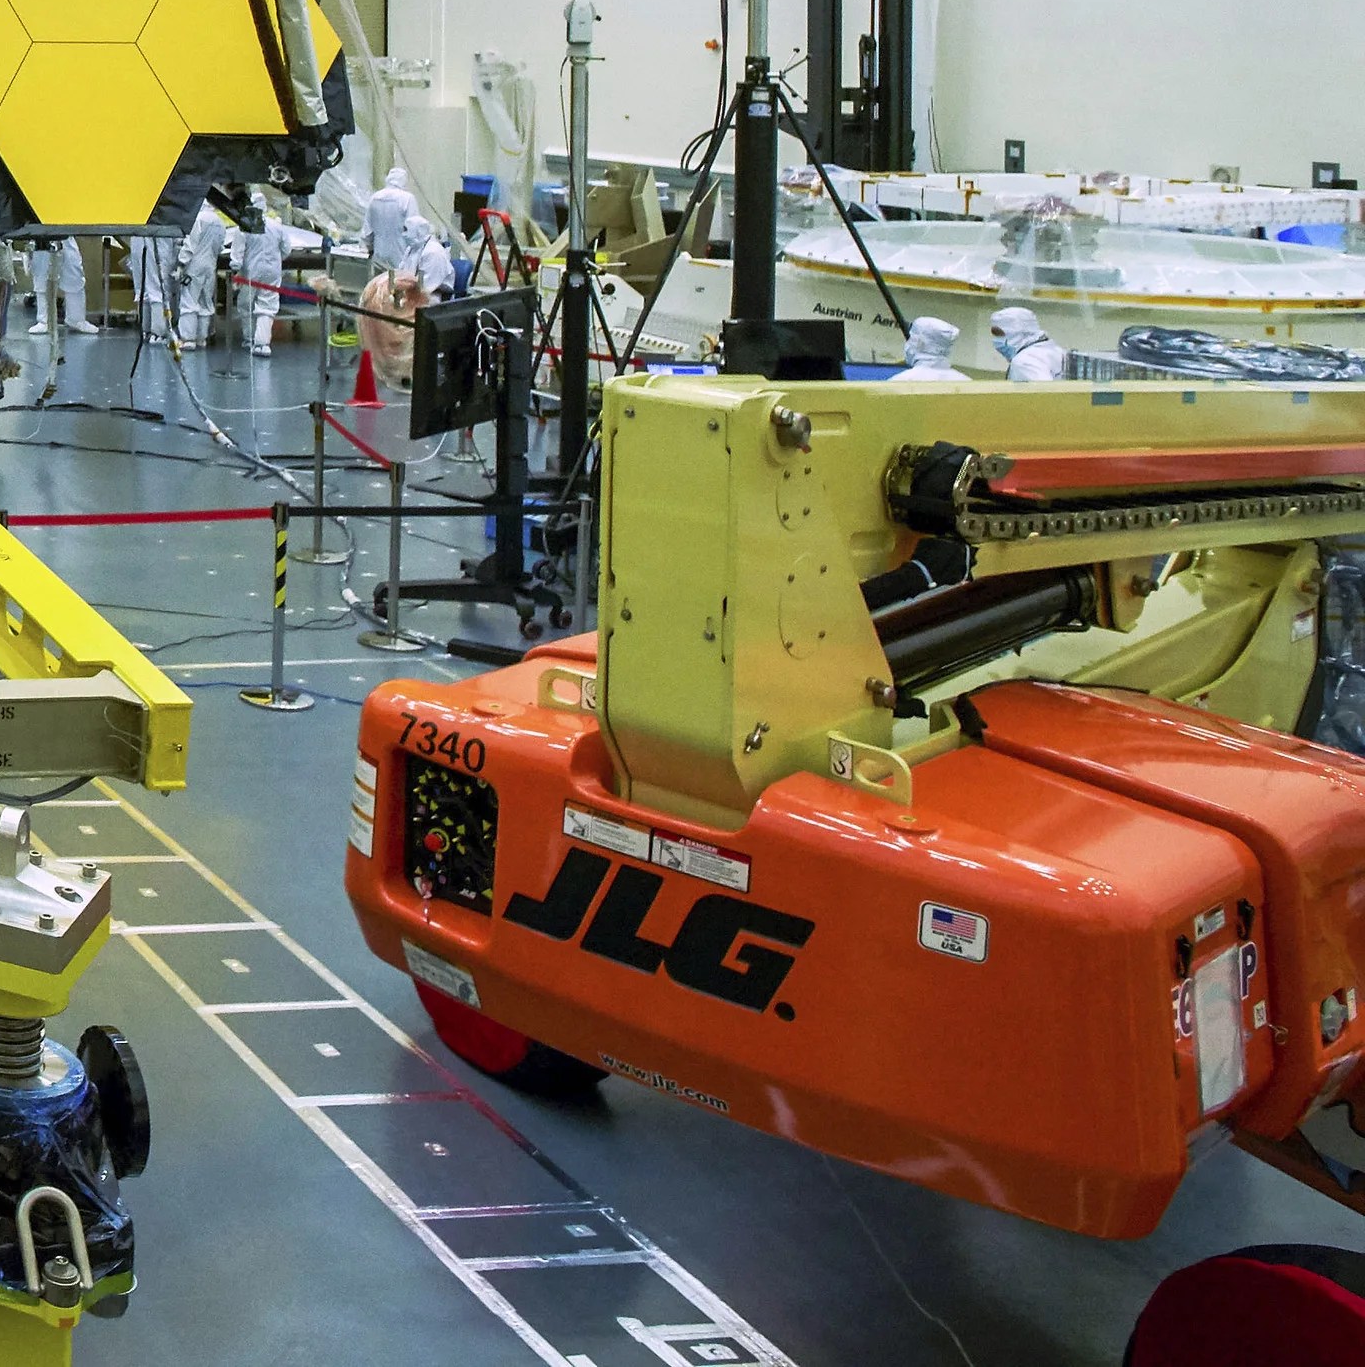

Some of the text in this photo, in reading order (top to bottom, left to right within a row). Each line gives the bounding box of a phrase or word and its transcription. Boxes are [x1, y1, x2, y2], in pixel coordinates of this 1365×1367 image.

[812, 302, 863, 322] Austrian
[399, 711, 486, 773] 7340
[941, 941, 963, 954] USA
[597, 1051, 730, 1114] www.jlg.com
